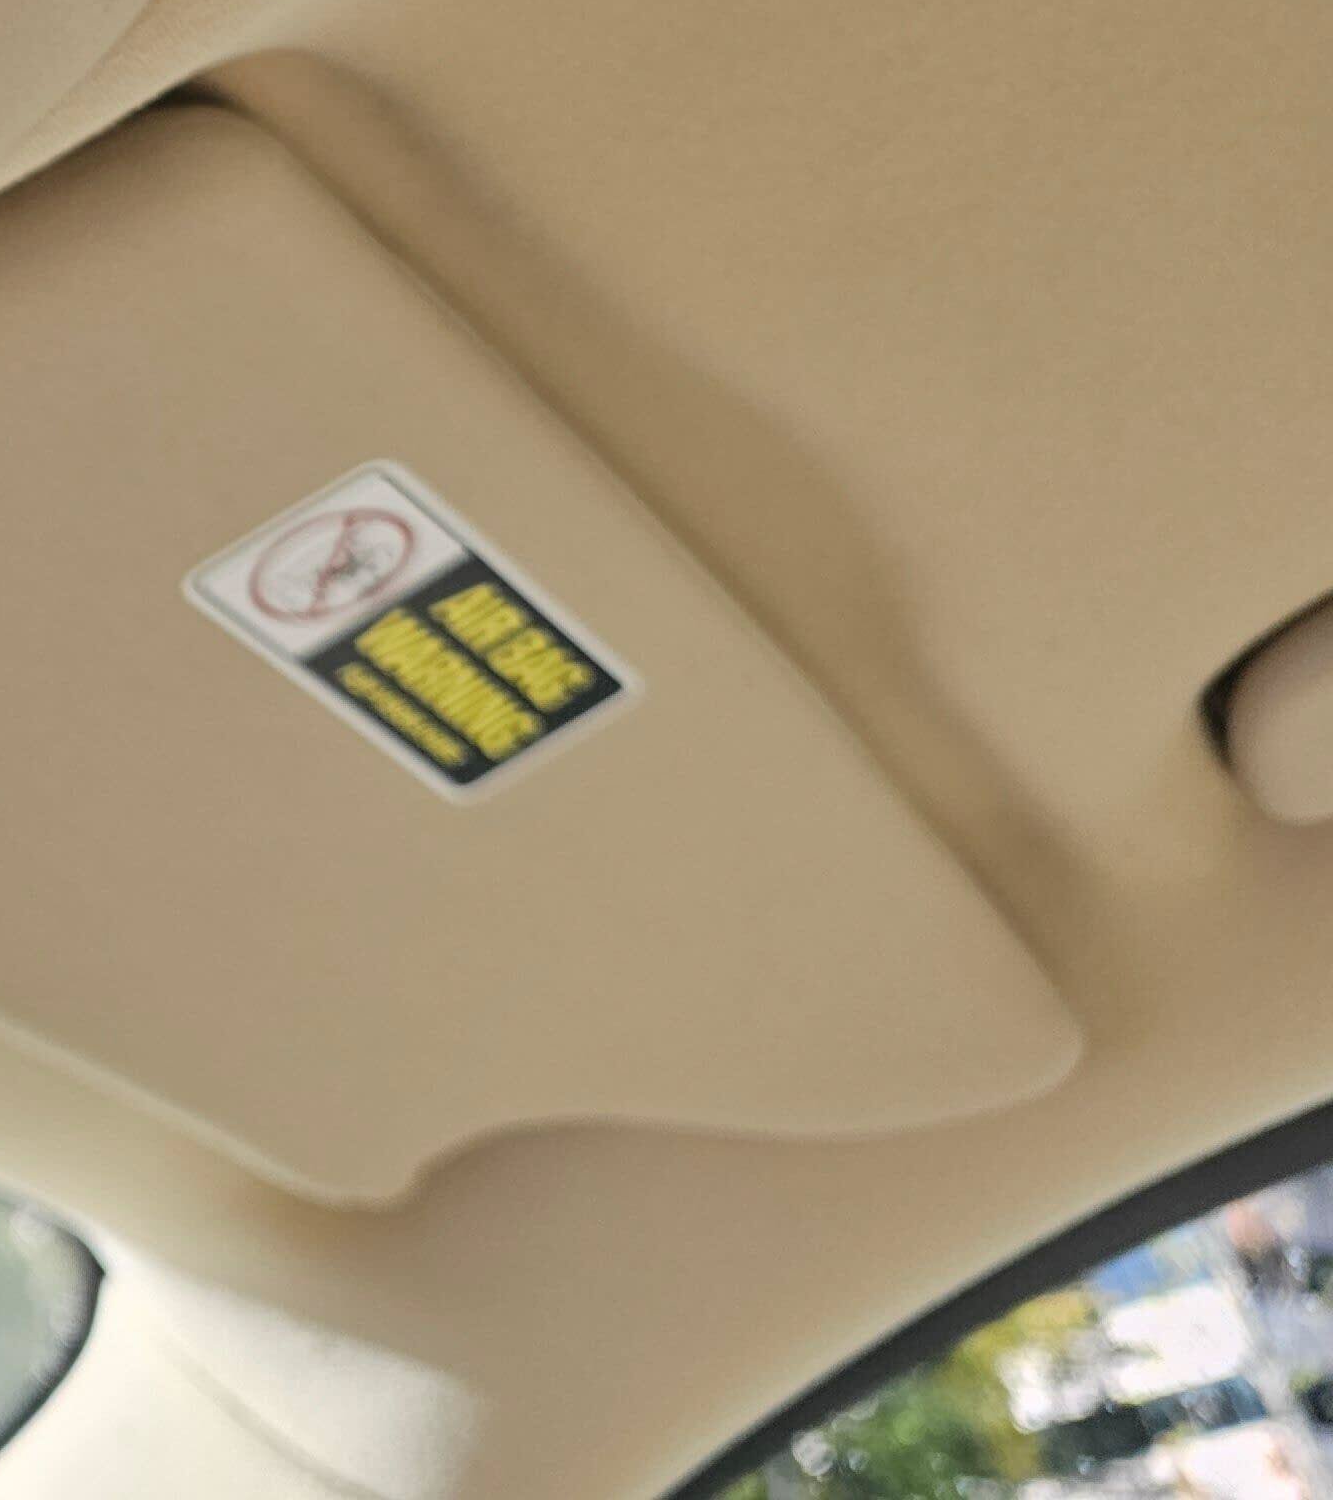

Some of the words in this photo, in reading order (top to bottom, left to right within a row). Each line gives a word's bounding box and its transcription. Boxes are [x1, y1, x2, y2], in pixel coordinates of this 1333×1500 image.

[353, 607, 542, 761] WARNING
[428, 582, 527, 652] AIR
[484, 625, 593, 712] BAG
